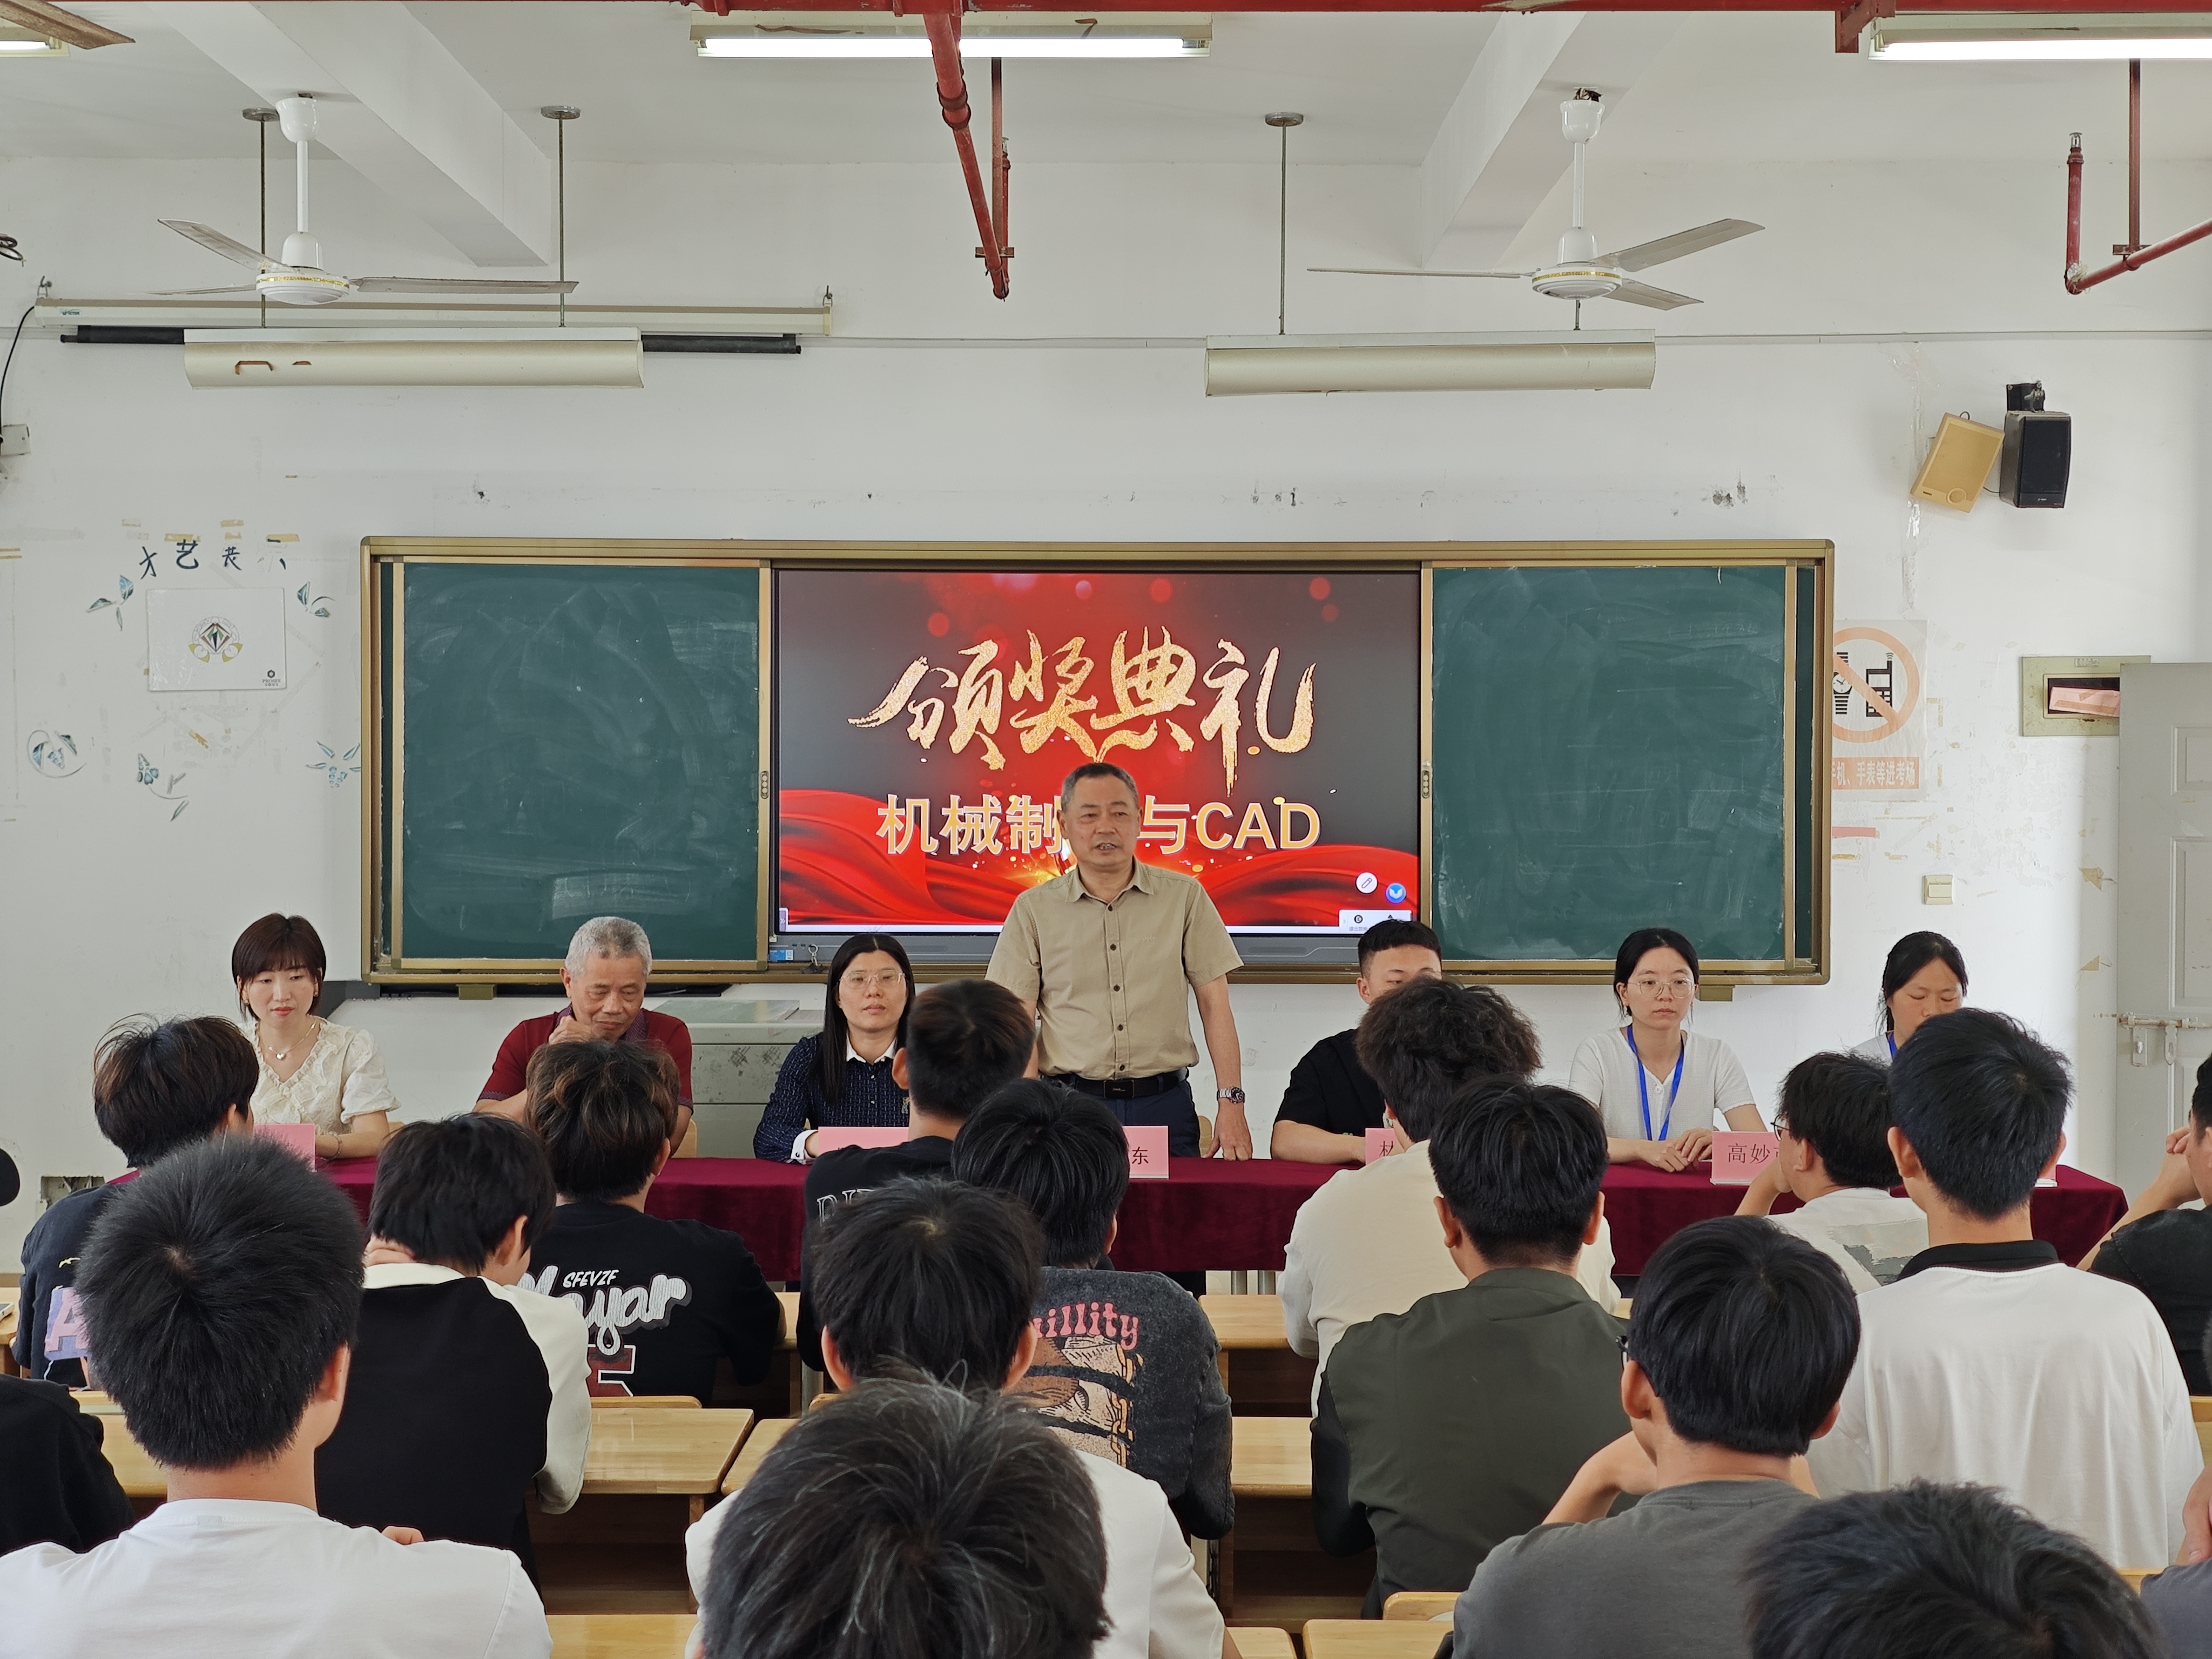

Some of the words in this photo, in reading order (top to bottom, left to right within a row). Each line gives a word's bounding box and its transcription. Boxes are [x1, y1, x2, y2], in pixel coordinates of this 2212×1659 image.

[847, 625, 1317, 798] 颁奖典礼
[876, 794, 1321, 857] 机械制与CAD
[1132, 1147, 1149, 1165] 东
[1728, 1143, 1779, 1164] 高妙
